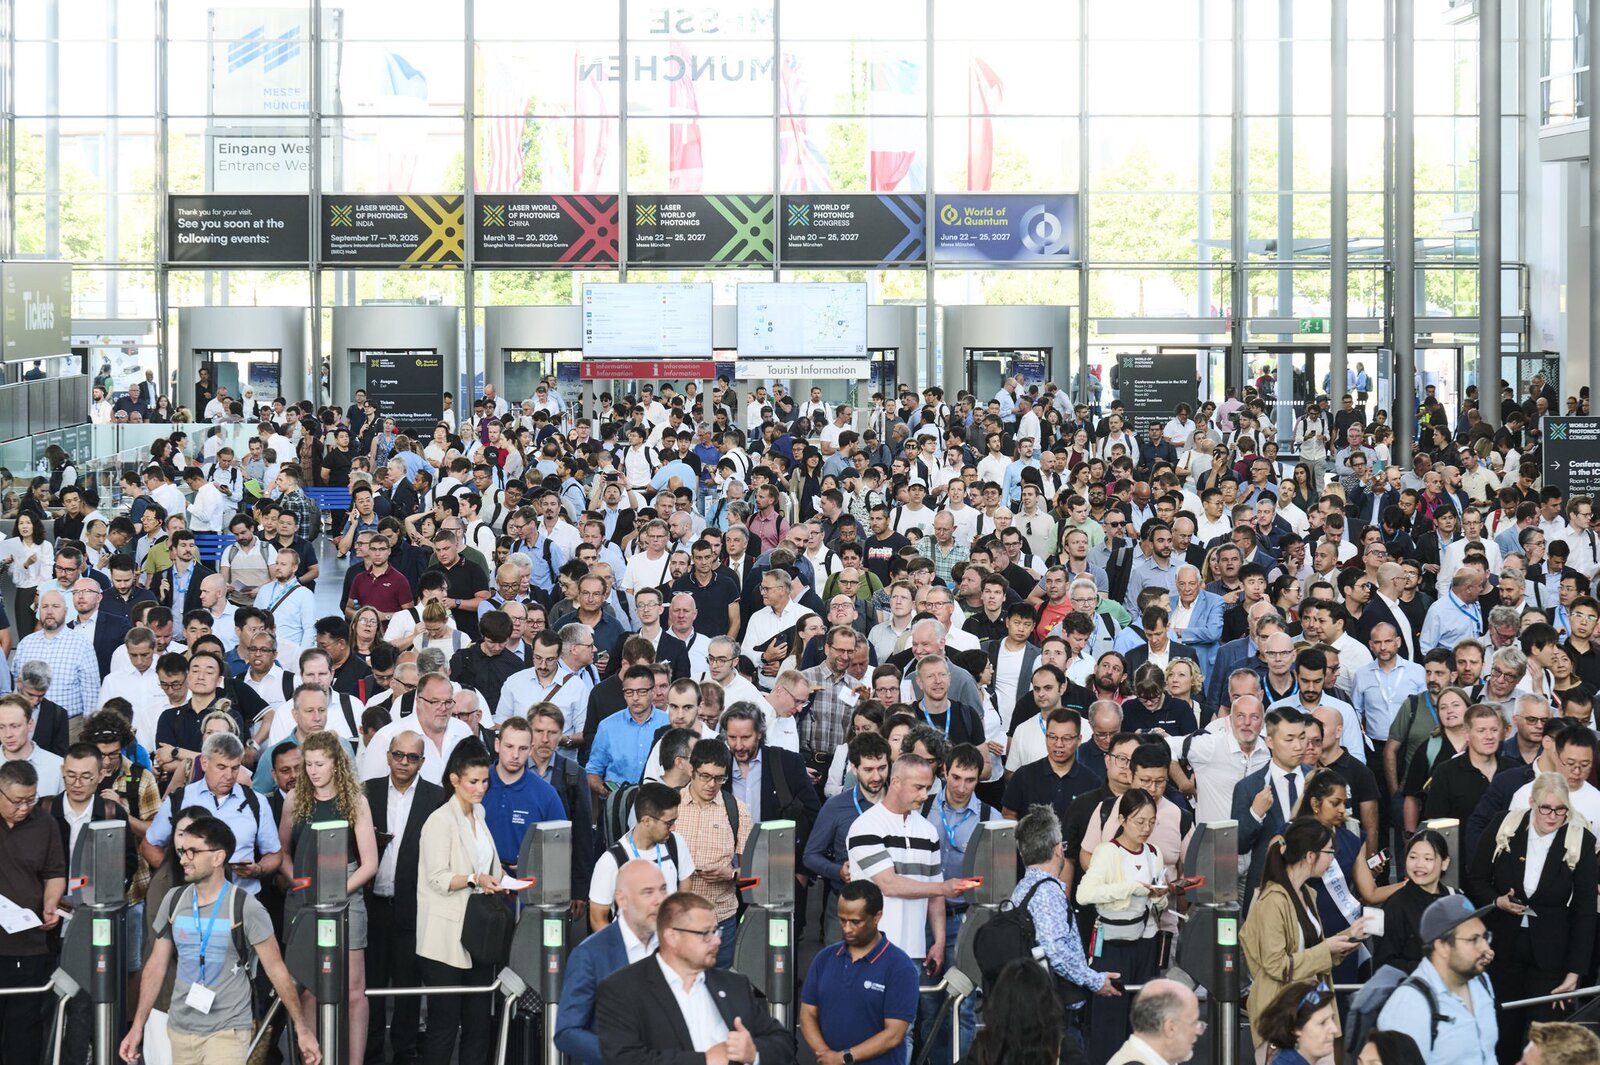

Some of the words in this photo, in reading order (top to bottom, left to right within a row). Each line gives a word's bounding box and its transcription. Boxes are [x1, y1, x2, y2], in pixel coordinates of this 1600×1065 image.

[264, 102, 310, 110] MÜNCH
[219, 143, 276, 156] Eingang
[219, 160, 280, 171] Entrance
[964, 208, 993, 216] World
[996, 208, 1006, 216] of
[178, 217, 199, 228] See
[201, 221, 221, 231] you
[253, 219, 264, 228] at
[266, 218, 284, 228] the
[964, 217, 1008, 225] Quantum
[178, 233, 227, 246] following
[231, 234, 269, 243] events:
[23, 290, 54, 331] Tickets
[767, 365, 798, 374] Tourist
[801, 364, 856, 374] Information
